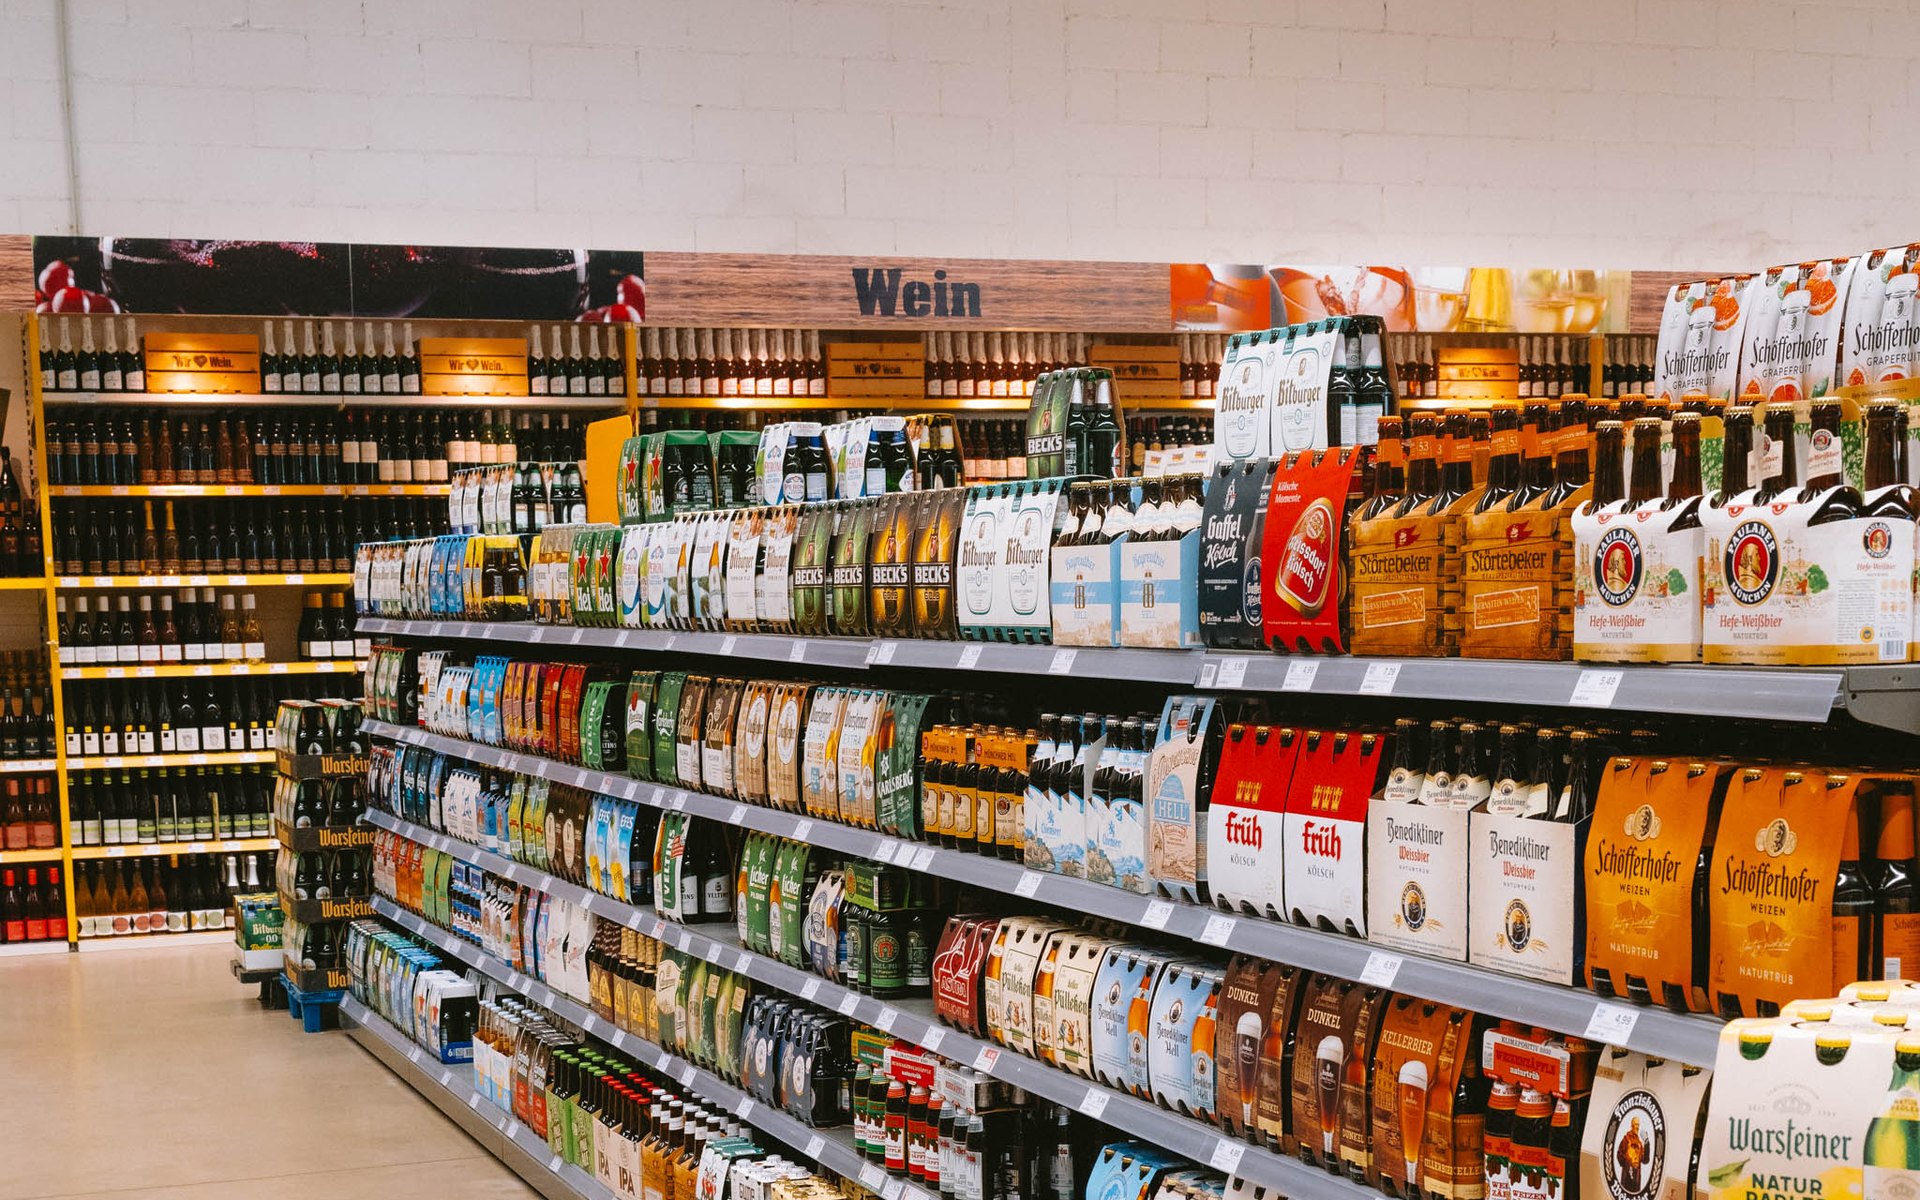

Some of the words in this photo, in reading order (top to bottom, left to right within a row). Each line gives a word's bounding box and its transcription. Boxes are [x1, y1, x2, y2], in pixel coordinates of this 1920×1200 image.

[853, 268, 982, 317] Wein
[1750, 332, 1828, 368] Schöfferhofer
[174, 356, 191, 367] Wir
[449, 359, 464, 370] Wir
[481, 360, 503, 371] Wein.
[1663, 346, 1730, 381] Schöfferhofer
[1762, 364, 1812, 378] GRAPEFRUIT
[1277, 378, 1321, 408] Bitburger
[1673, 377, 1715, 390] GRAPEFRUIT
[1221, 386, 1265, 414] Bitburger
[1027, 434, 1063, 455] BECK'S
[1277, 481, 1299, 491] Kölsche
[1275, 494, 1301, 504] Momente
[1208, 514, 1242, 542] Gaffel
[1727, 521, 1776, 554] PAULANER
[1005, 536, 1043, 569] Bitburger
[1598, 528, 1641, 559] PAULANER
[962, 540, 997, 570] Bitburger
[1204, 541, 1238, 569] Kölsch
[1288, 535, 1326, 580] Reissdorf
[1360, 553, 1432, 575] Störtebeker
[1471, 550, 1547, 573] Störtebeker
[795, 565, 823, 585] BECK'S
[833, 565, 863, 585] BECK'S
[872, 565, 907, 584] BECK'S
[914, 564, 950, 583] BECK'S
[1286, 554, 1314, 593] Kölsch
[1857, 562, 1897, 571] Hefe-Weißbier
[1599, 584, 1636, 604] MÜNCHEN
[1730, 581, 1772, 604] MÜNCHEN
[1590, 614, 1646, 631] Hefe-Weißbier
[1719, 614, 1783, 632] Hefe-Weißbier
[1732, 631, 1768, 640] NATURTRÜB
[321, 755, 370, 776] Warstein
[877, 769, 913, 800] KARLSBERG
[598, 808, 610, 823] EFES
[621, 815, 634, 830] EFES
[1158, 805, 1186, 820] HELL
[1225, 811, 1262, 852] früh
[1302, 821, 1341, 862] früh
[1386, 817, 1444, 846] Benediktiner
[1399, 846, 1430, 864] Weissbier
[1489, 830, 1549, 862] Benediktiner
[662, 828, 676, 900] VELTINS
[1230, 854, 1256, 867] KÖLSCH
[1503, 860, 1535, 880] Weissbier
[1595, 839, 1681, 885] Schöfferhofer
[750, 863, 769, 886] Licher
[1307, 865, 1334, 879] KÖLSCH
[1722, 855, 1819, 903] Schöfferhofer
[783, 873, 800, 896] Licher
[1620, 883, 1650, 896] WEIZEN
[1750, 902, 1786, 916] WEIZEN
[252, 922, 283, 937] Bitburg
[940, 974, 967, 998] ASTRA
[1002, 972, 1031, 998] Pülleken
[1055, 989, 1088, 1016] Pülleken
[1228, 987, 1259, 1007] DUNKEL
[1098, 1004, 1125, 1026] Benediktiner
[1307, 1007, 1341, 1030] DUNKEL
[1105, 1023, 1118, 1037] Hell
[1157, 1022, 1188, 1045] Benediktiner
[1166, 1043, 1179, 1058] Hell
[1382, 1029, 1433, 1056] KELLERBIER
[1510, 1067, 1540, 1081] naturtrüb
[1259, 1100, 1279, 1114] DUNKEL
[1614, 1093, 1663, 1131] Franziskaner
[1342, 1128, 1364, 1145] DUNKEL
[1729, 1117, 1852, 1161] Warsteiner
[599, 1150, 610, 1180] IPA
[619, 1166, 635, 1196] IPA
[1752, 1173, 1822, 1195] NATUR
[1513, 1190, 1546, 1200] WEIZEN
